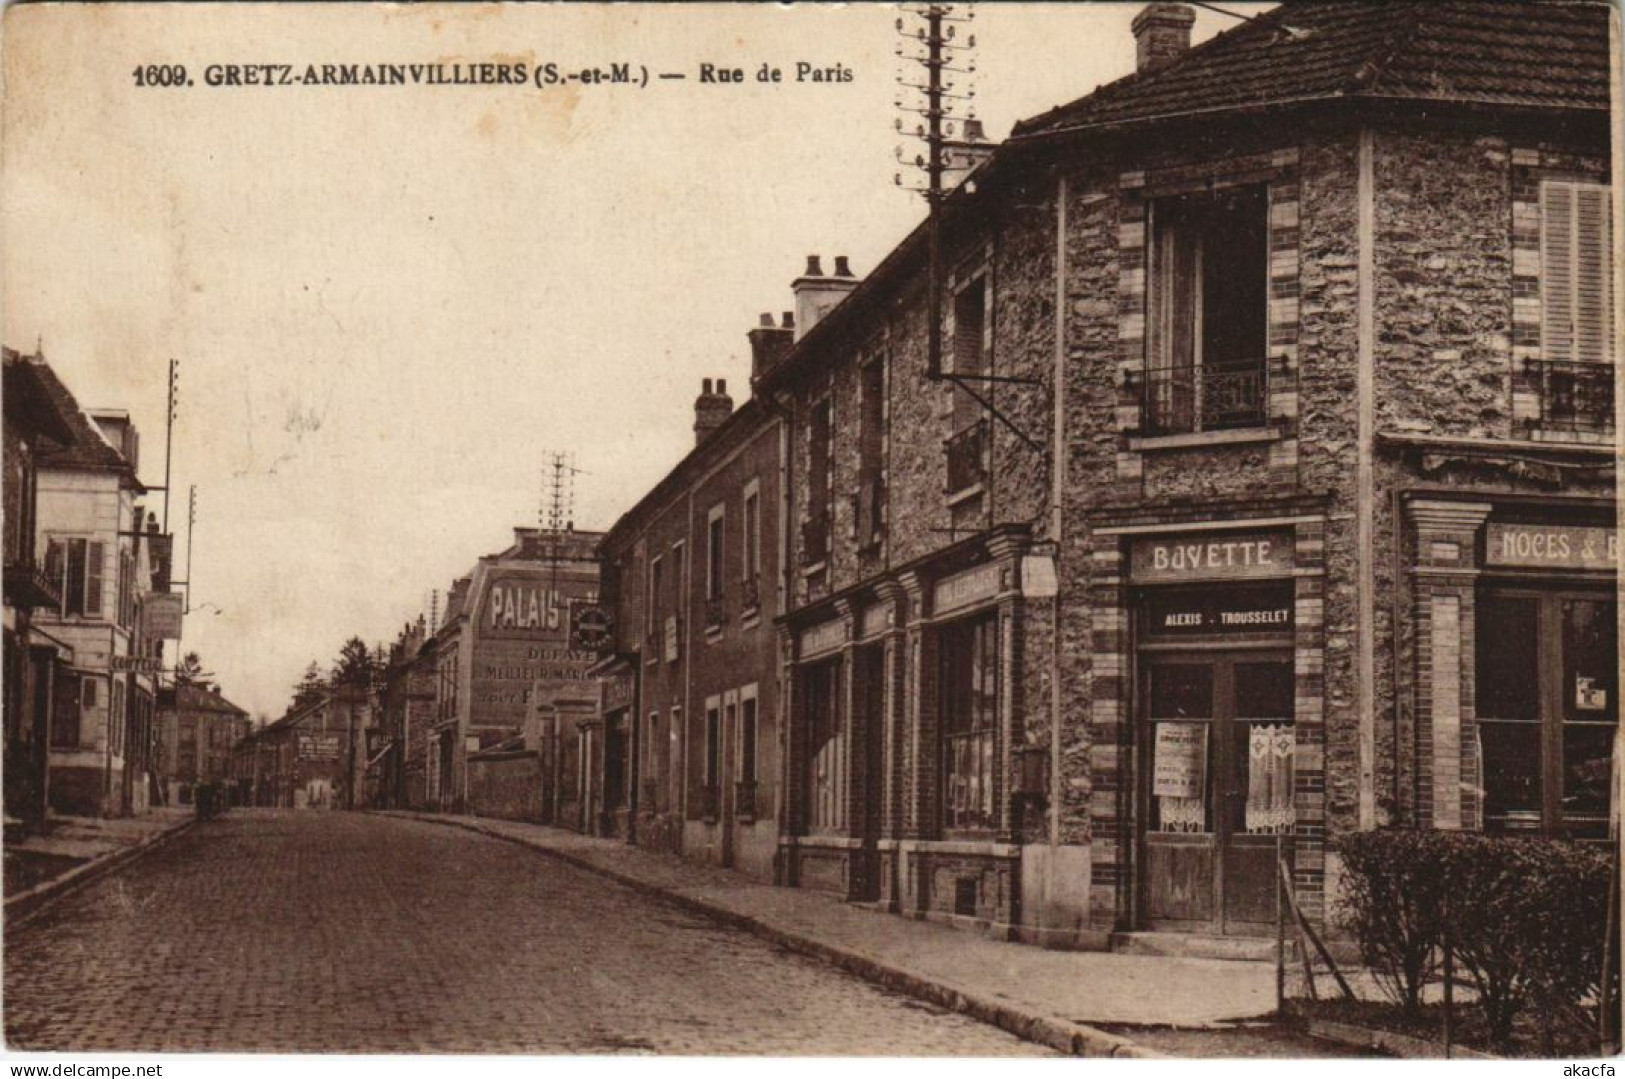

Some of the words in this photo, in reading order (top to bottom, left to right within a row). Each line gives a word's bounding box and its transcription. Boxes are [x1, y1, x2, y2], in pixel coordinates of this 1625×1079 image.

[1153, 540, 1273, 571] BUVETTE
[1503, 531, 1571, 560] NOCES
[1580, 539, 1597, 560] &
[491, 586, 560, 629] PALAIS
[1164, 612, 1203, 627] ALEXIS
[1220, 608, 1289, 625] TROUSSELET
